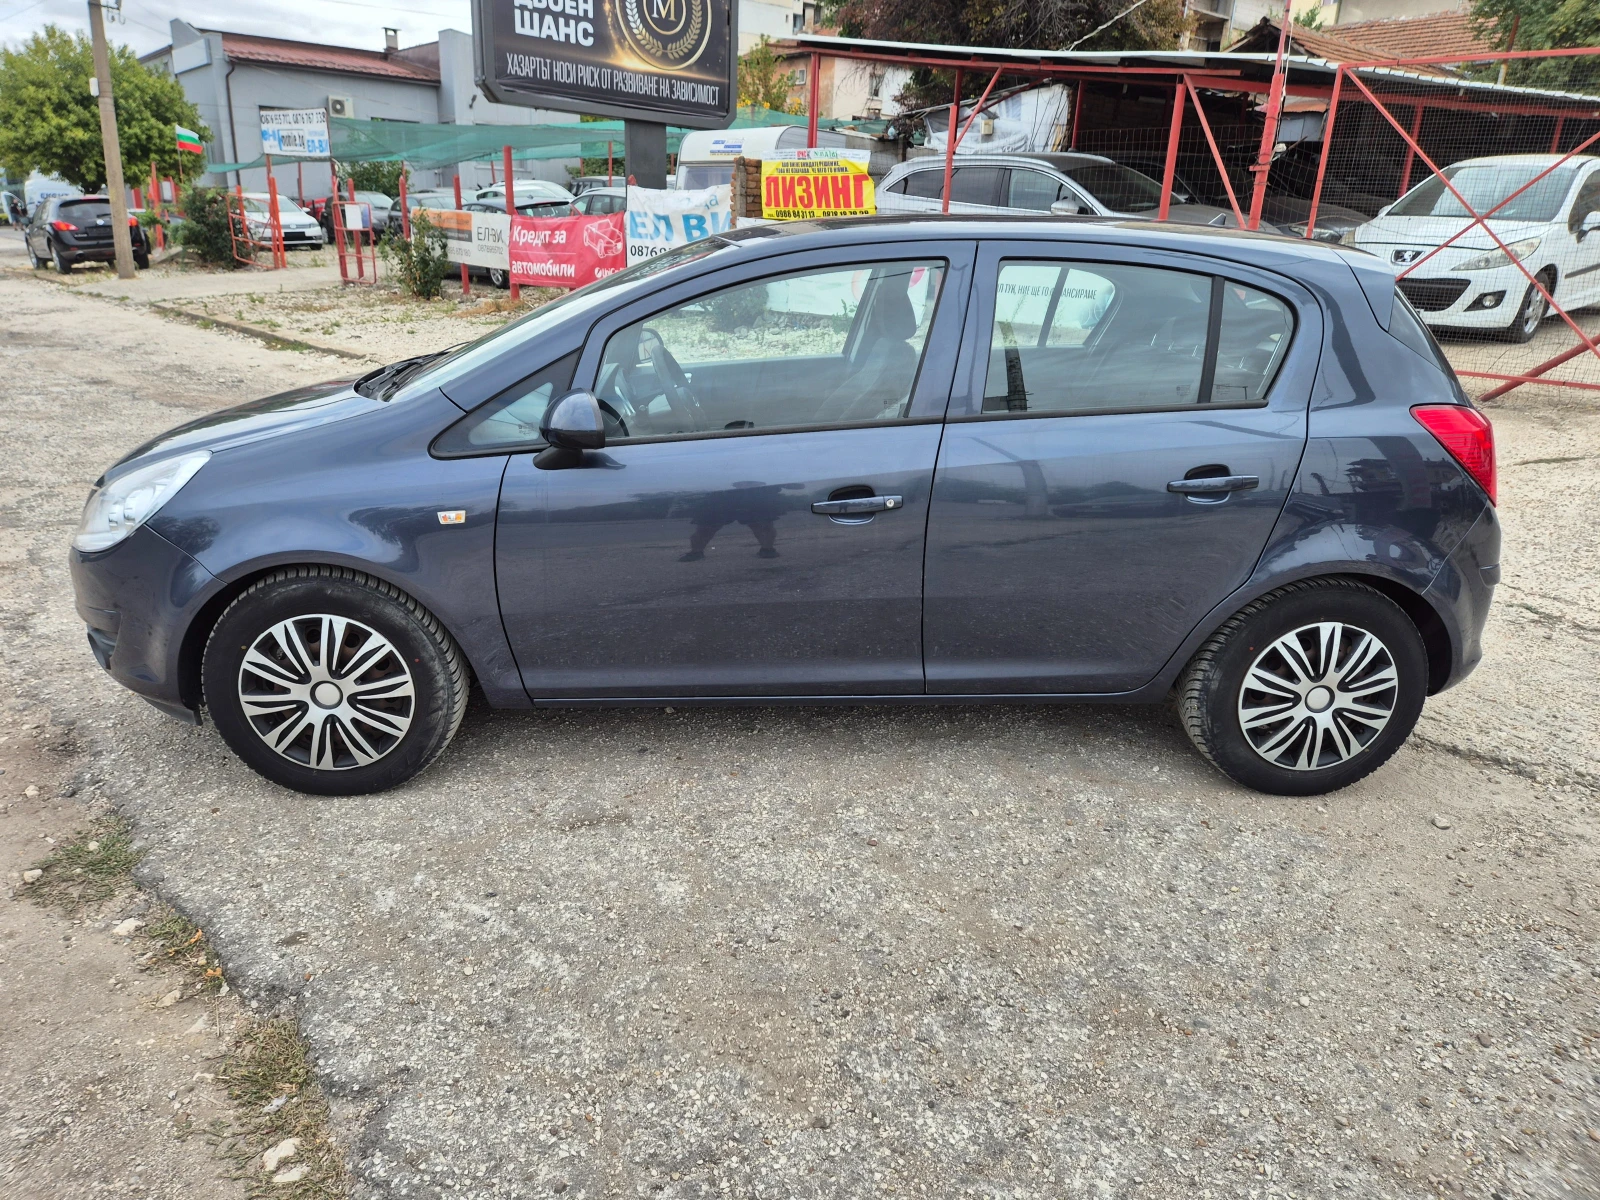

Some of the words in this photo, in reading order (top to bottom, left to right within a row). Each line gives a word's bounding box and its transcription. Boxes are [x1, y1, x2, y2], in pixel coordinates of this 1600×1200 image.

[514, 8, 594, 47] ШАНС
[506, 52, 551, 80] ХАЗАРТЪТ
[553, 60, 576, 84] НОСИ
[577, 64, 600, 88] РИСК
[601, 68, 612, 90] ОТ
[613, 70, 658, 96] РАЗВИВАНЕ
[659, 77, 671, 99] НА
[671, 79, 720, 106] ЗАВИСИМОСТ
[765, 174, 870, 209] ЛИЗИНГ
[477, 226, 504, 243] ЕЛ-ВИ
[512, 225, 551, 246] Кредит
[552, 230, 567, 244] за
[629, 210, 674, 242] ЕЛ
[511, 260, 576, 277] автомобили
[1018, 285, 1030, 295] НИЕ
[1031, 286, 1041, 297] ЩЕ
[1041, 286, 1049, 297] ГО
[1050, 287, 1097, 300] АНСИРАМЕ
